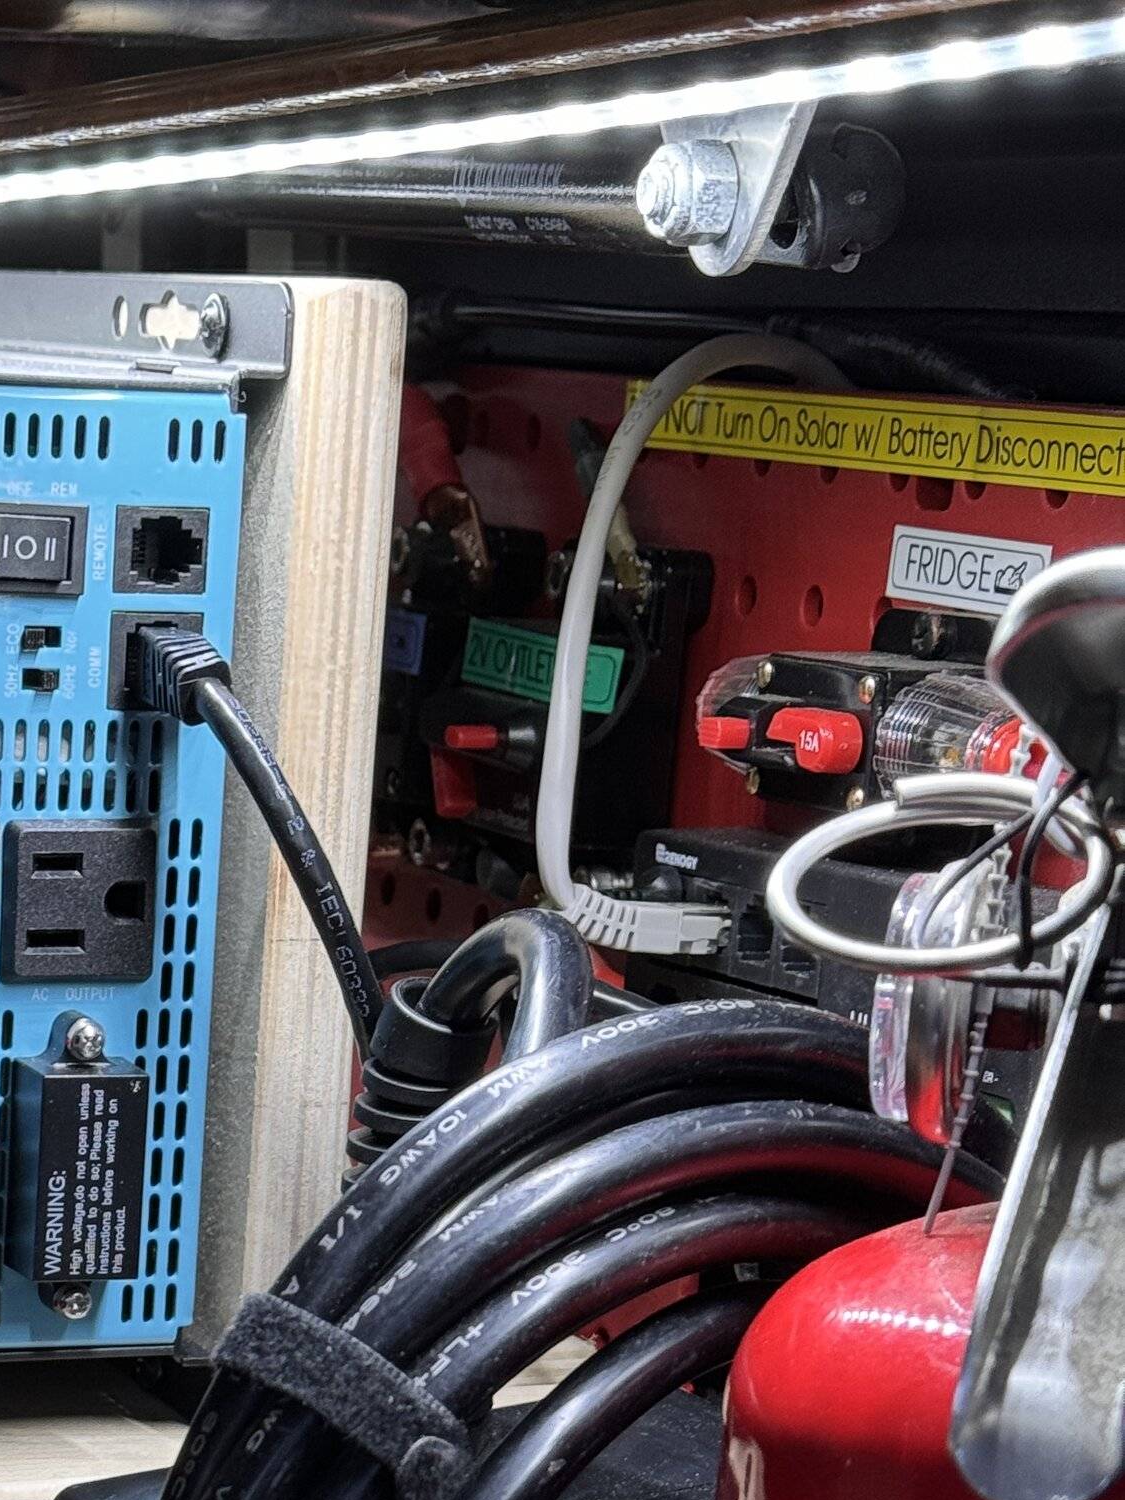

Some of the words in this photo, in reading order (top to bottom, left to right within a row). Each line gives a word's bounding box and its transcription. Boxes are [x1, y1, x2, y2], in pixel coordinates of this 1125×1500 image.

[715, 401, 754, 441] Turn
[759, 405, 790, 444] On
[795, 407, 848, 450] Solar
[854, 415, 885, 458] w/
[887, 417, 972, 468] Battery
[50, 482, 78, 496] REM
[92, 523, 107, 581] REMOTE
[905, 543, 994, 593] FRIDGE
[6, 623, 20, 655] ECO
[88, 646, 101, 688] COMM
[799, 729, 820, 753] 15A
[32, 987, 50, 1001] AC
[65, 986, 116, 1001] OUTPUT
[79, 1083, 91, 1120] unless
[94, 1089, 105, 1115] read
[108, 1099, 118, 1114] on
[78, 1127, 89, 1155] open
[92, 1122, 103, 1160] Please
[106, 1120, 119, 1163] working
[76, 1161, 87, 1178] not
[89, 1186, 100, 1201] do
[102, 1170, 114, 1205] before
[44, 1170, 66, 1275] WARNING:
[88, 1207, 98, 1218] to
[70, 1249, 83, 1275] High
[113, 1254, 123, 1273] this
